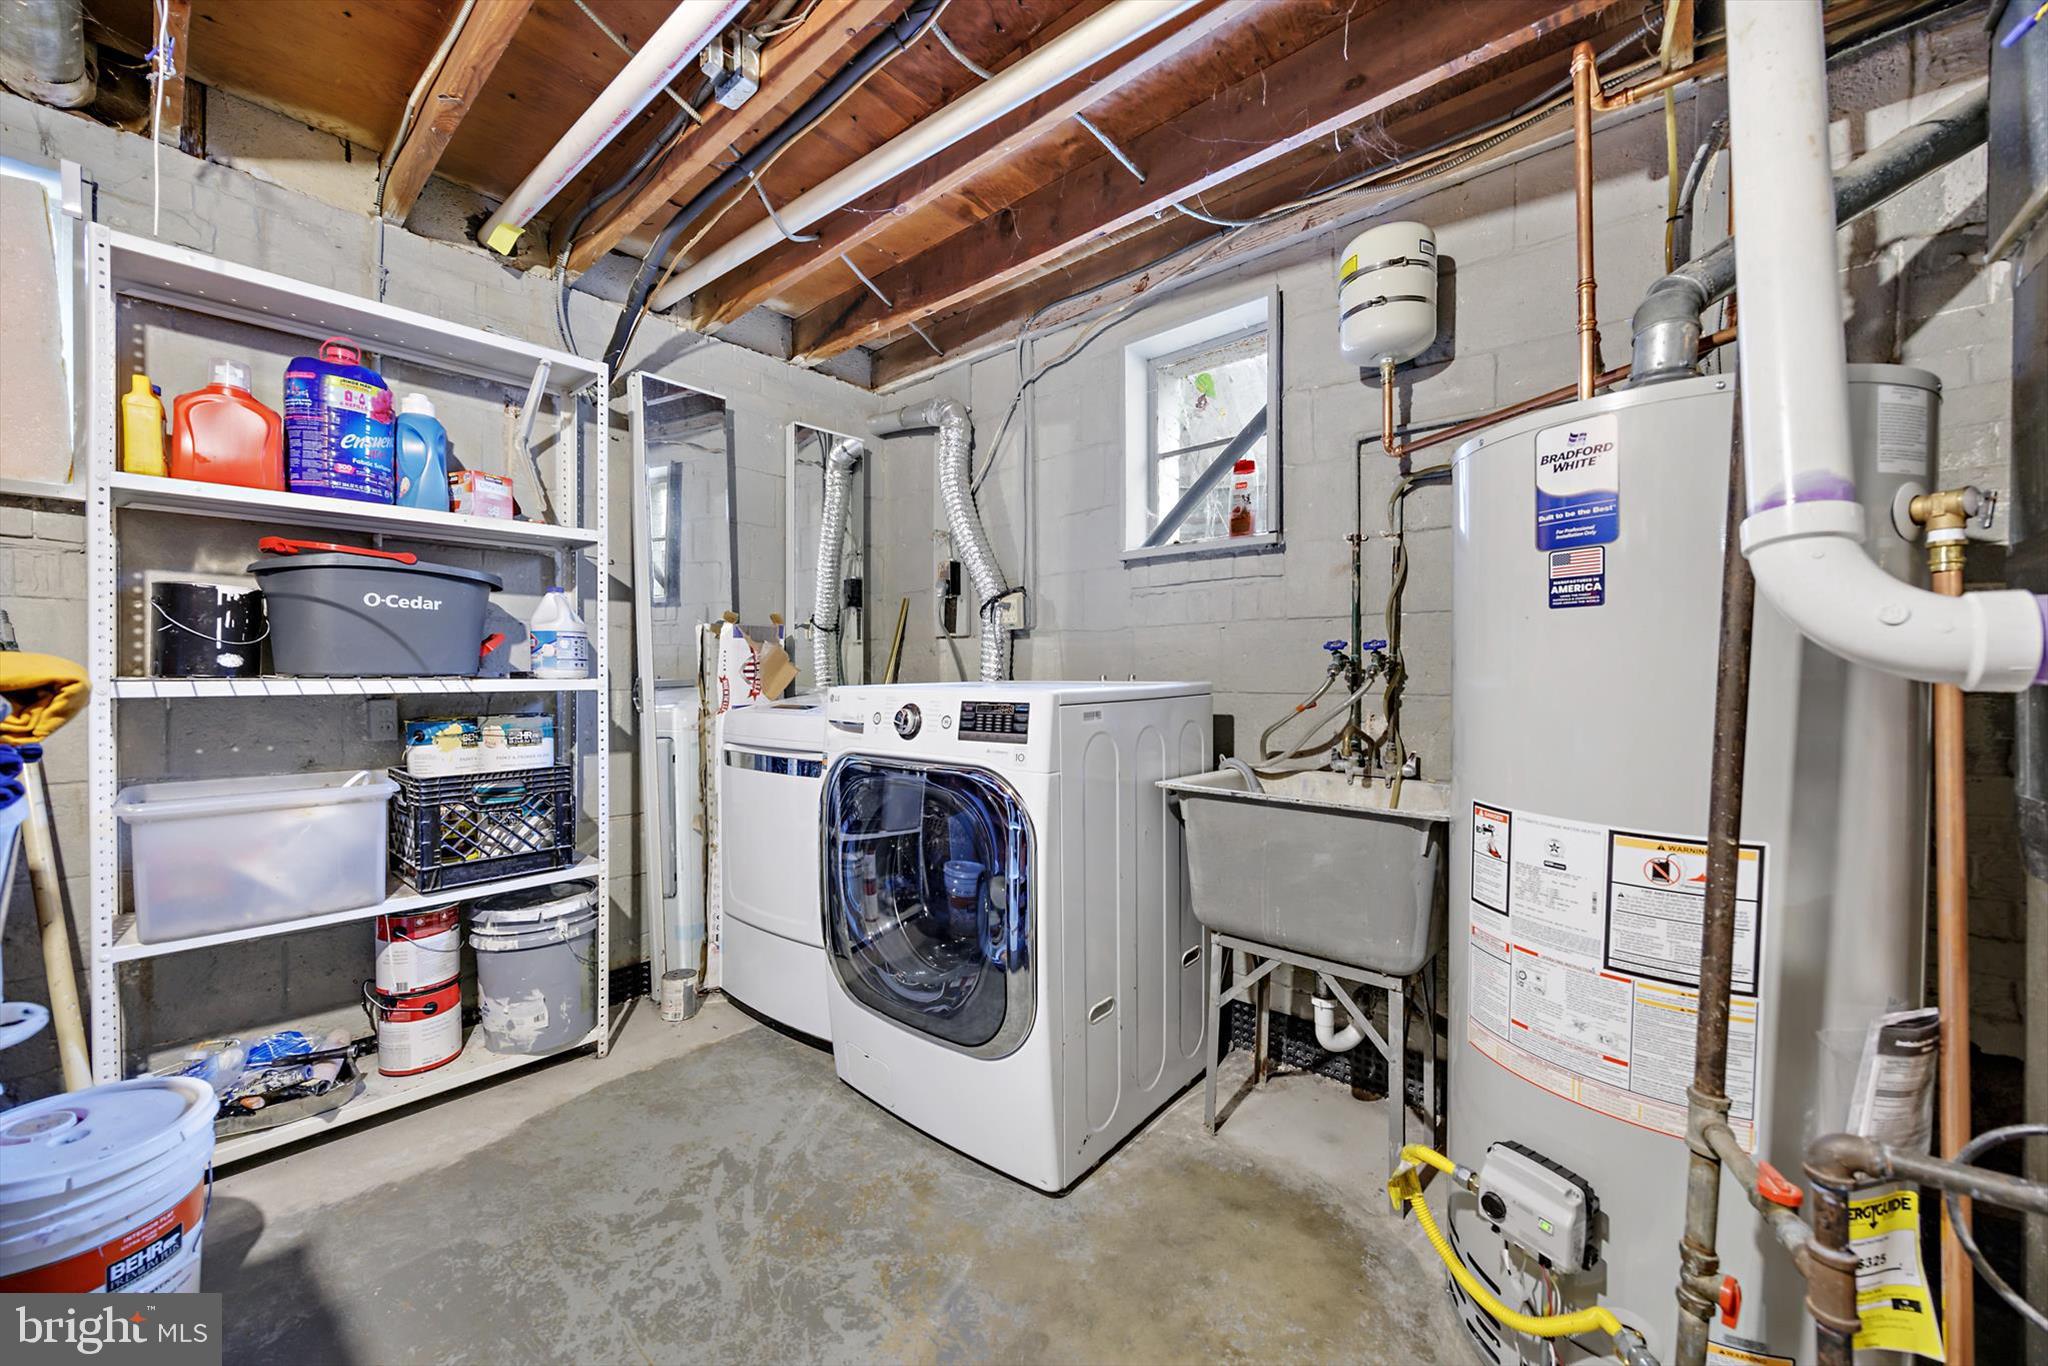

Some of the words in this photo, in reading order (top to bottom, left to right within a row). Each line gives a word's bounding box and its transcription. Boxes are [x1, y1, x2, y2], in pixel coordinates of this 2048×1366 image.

[1540, 442, 1614, 466] BRADFORD
[1553, 456, 1597, 474] WHITE
[1538, 513, 1555, 523] Built
[1555, 512, 1564, 520] to
[1577, 508, 1592, 516] the
[1555, 532, 1584, 540] Installation
[1564, 525, 1596, 534] Professional
[1551, 582, 1602, 594] AMERICA
[363, 592, 442, 611] O-Cedar
[110, 1240, 164, 1281] BEHR
